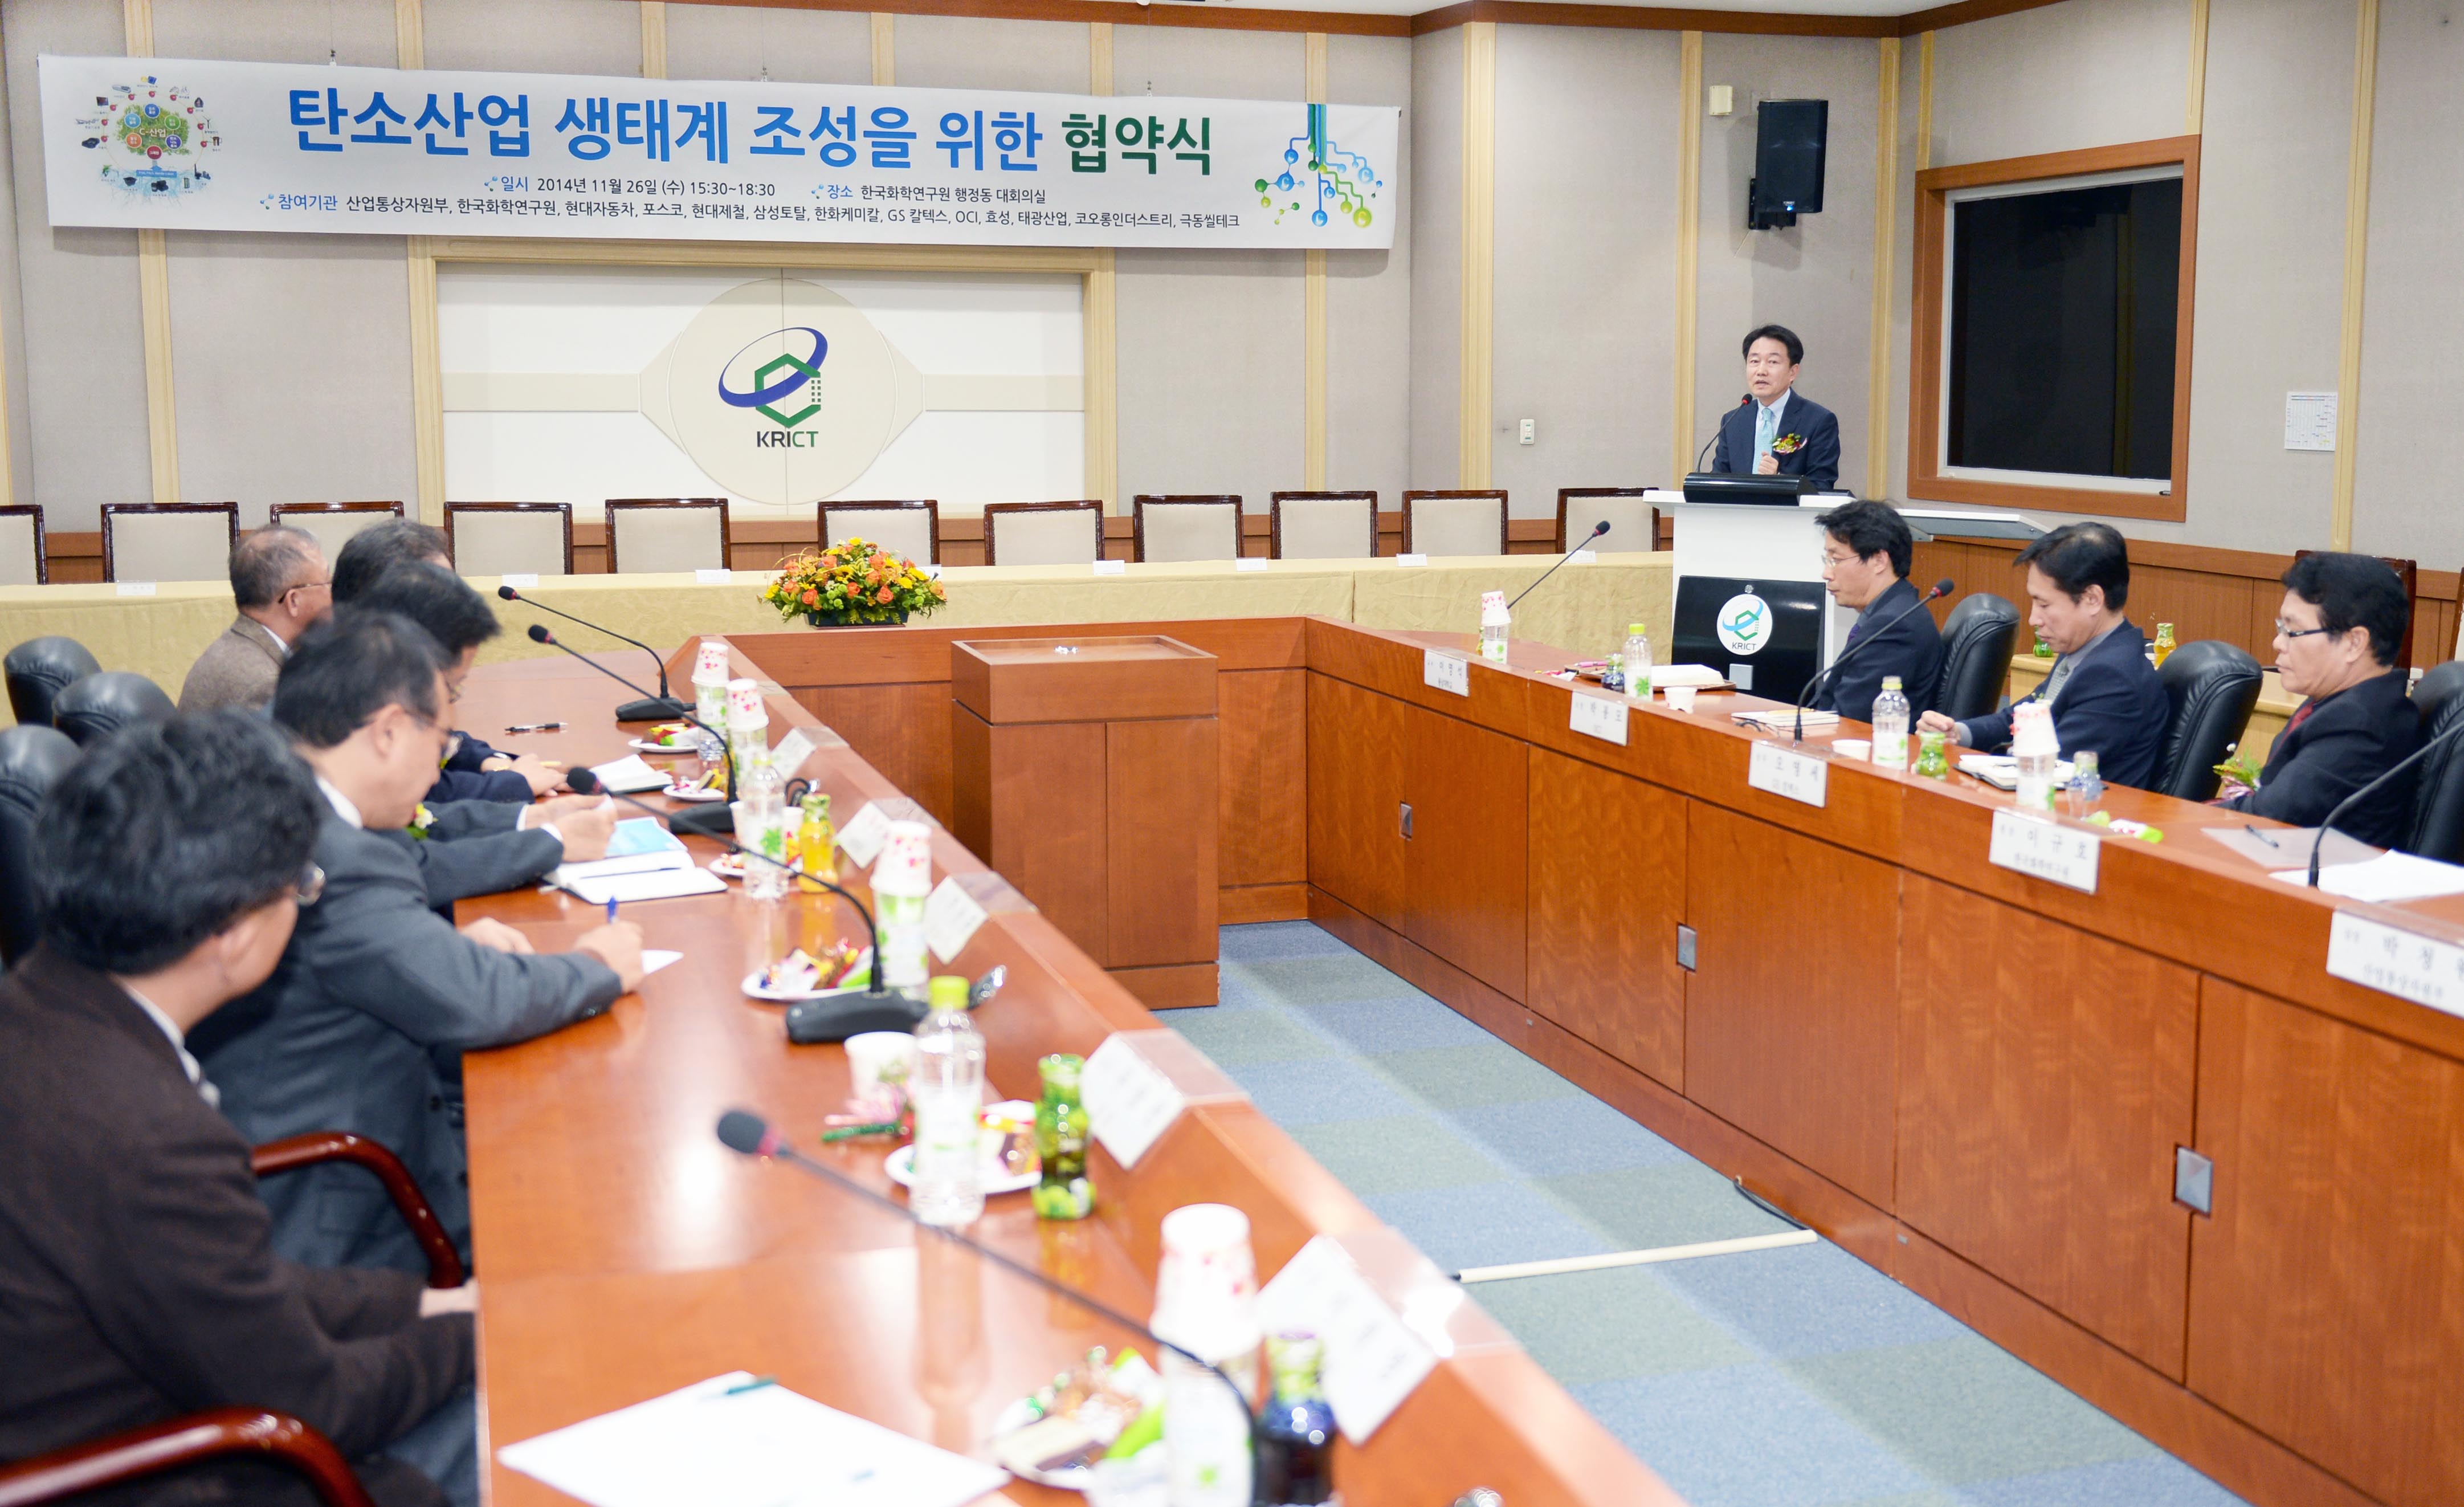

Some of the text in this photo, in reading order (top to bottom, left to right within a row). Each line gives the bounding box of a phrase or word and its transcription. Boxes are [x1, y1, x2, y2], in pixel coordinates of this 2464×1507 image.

[289, 88, 1210, 176] 탄소산업 생태계 조성을 위한 협약식
[501, 177, 774, 195] 일시 2014년 11월 26일 (수) 15:30~18:30
[828, 185, 1045, 203] 장소 한국화학연구원 행정동 대회의실
[279, 194, 1239, 228] 참여기관 산업통상자원부, 한국화학연구원, 현대자동차, 포스코, 현대제철, 삼성토탈, 한화케미칼, GS 칼텍스, OCI, 효성, 태광산업, 코오롱인더스트리, 극동씰테크
[757, 431, 819, 447] KRICT
[1732, 642, 1757, 650] KRICT
